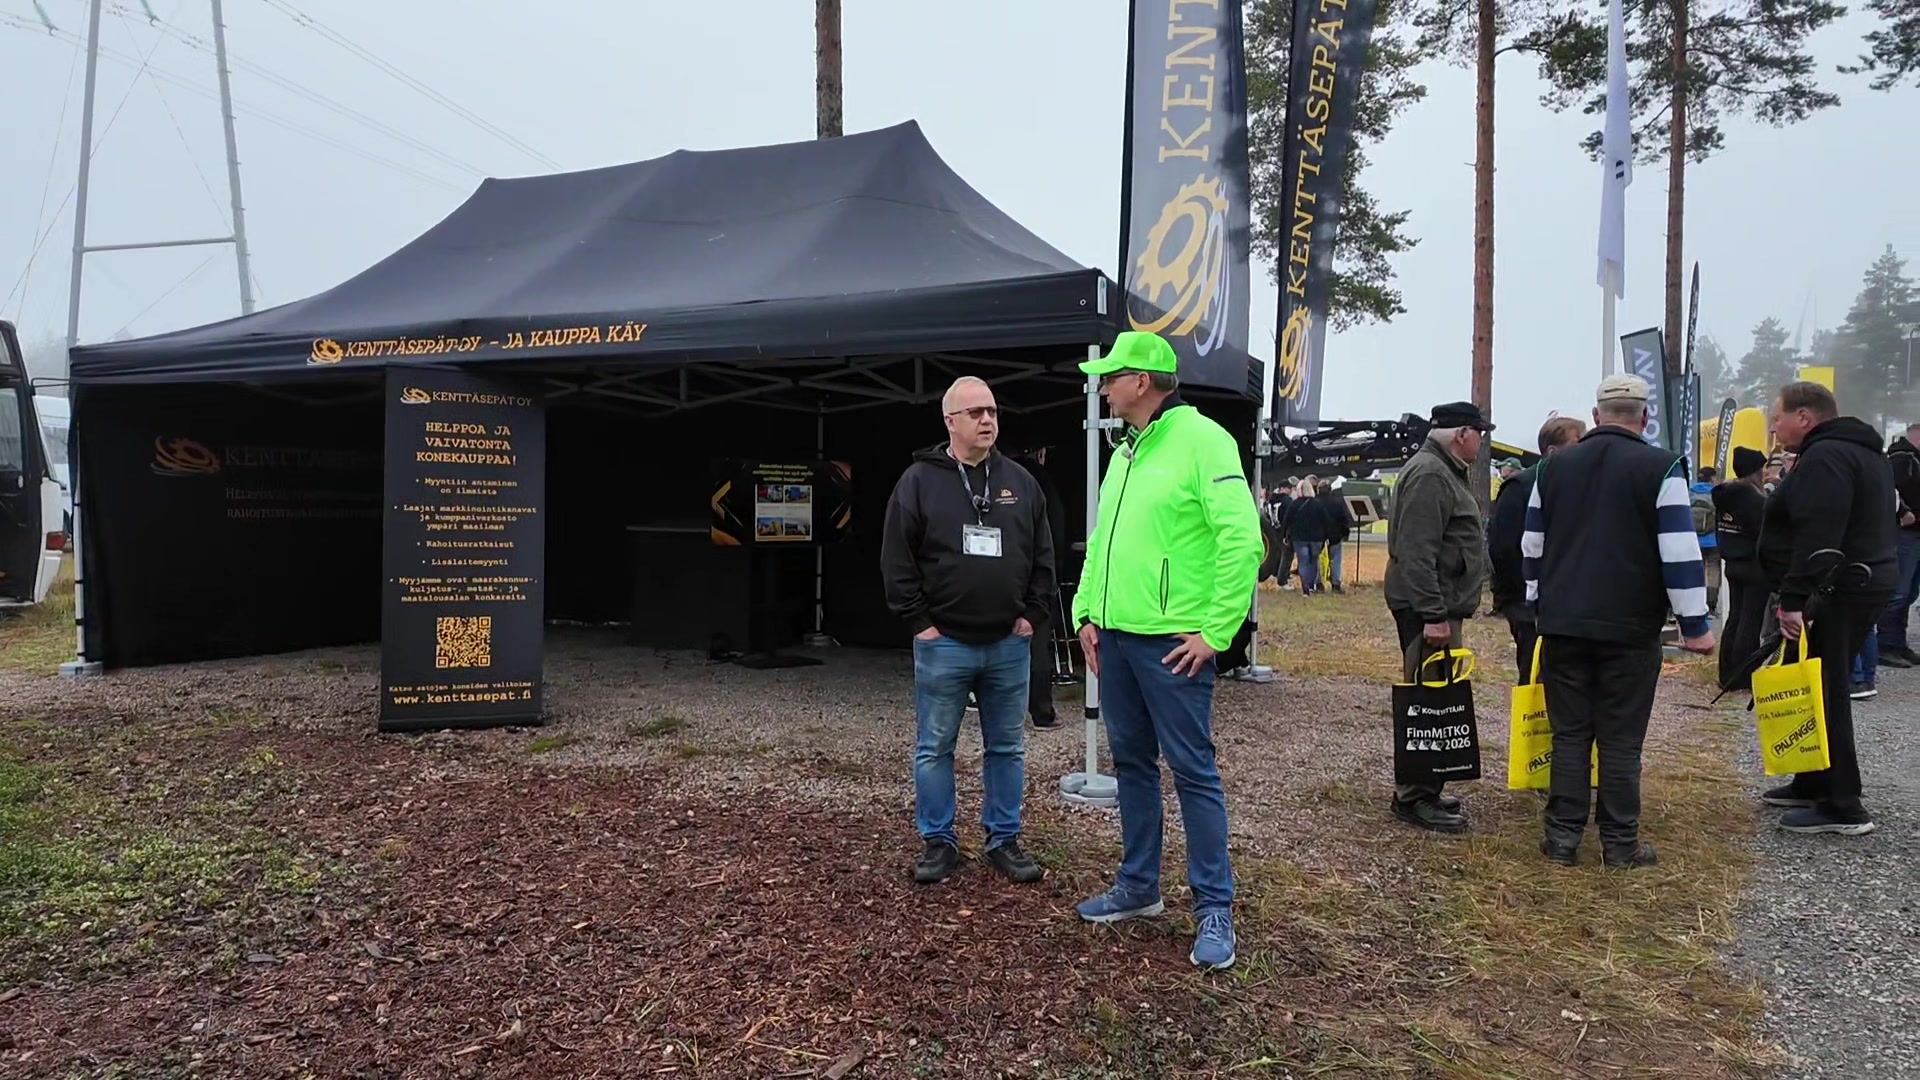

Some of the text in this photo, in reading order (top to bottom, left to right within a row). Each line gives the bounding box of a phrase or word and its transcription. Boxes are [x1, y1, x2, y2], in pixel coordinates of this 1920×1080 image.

[345, 335, 458, 358] KENTTÄSEPÄT
[502, 333, 523, 349] JA
[528, 327, 601, 347] KAUPPA
[605, 321, 648, 343] KÄY
[432, 391, 532, 407] KENTTÄSEPÄT OY
[425, 421, 512, 436] HELPPOA JA
[425, 437, 512, 450] VAIVATONTA
[416, 451, 517, 466] KONEKAUPPAA!
[424, 478, 518, 487] Myyntiin antaminen
[403, 504, 537, 514] Laajat markkinointikanavat
[420, 514, 430, 522] ja
[426, 522, 458, 531] ympäri
[426, 540, 515, 549] Rahoitusratkaisut
[393, 690, 532, 704] www.kenttasepat.fi
[1407, 723, 1470, 740] FinnMETKO
[1445, 737, 1471, 750] 2026
